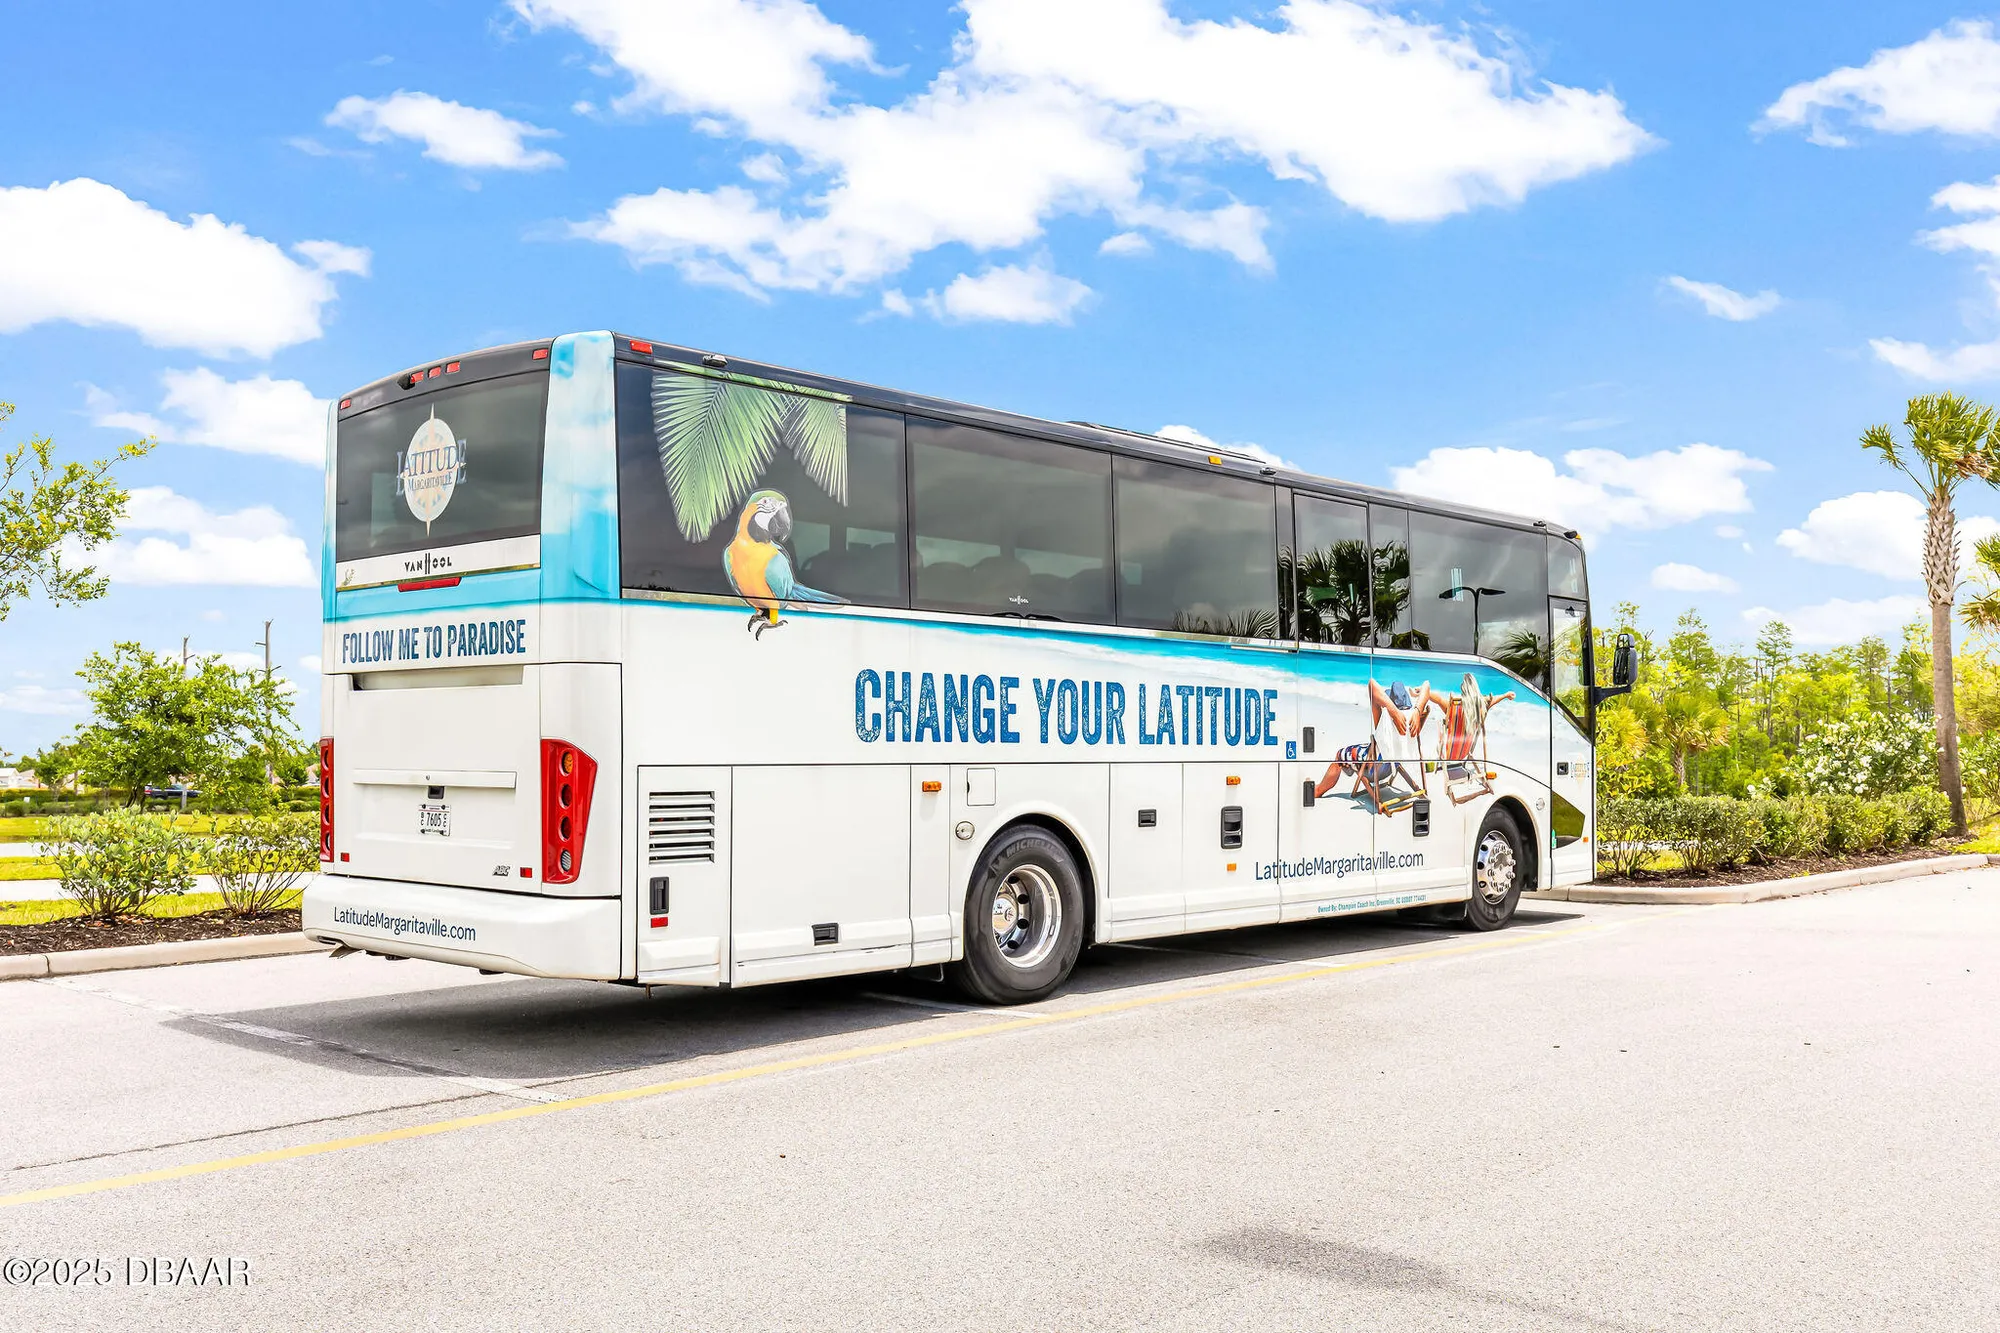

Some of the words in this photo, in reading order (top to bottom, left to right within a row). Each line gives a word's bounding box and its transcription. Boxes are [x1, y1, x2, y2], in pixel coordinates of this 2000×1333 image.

[342, 629, 394, 664] FOLLOW
[398, 627, 420, 660] ME
[423, 625, 442, 659] TO
[447, 619, 526, 658] PARADISE
[855, 668, 1020, 743] CHANGE
[1032, 678, 1126, 746] YOUR
[1138, 683, 1279, 746] LATITUDE
[1255, 851, 1424, 880] LatitudeMargaritaville.com
[334, 906, 476, 941] LatitudeMargaritaville.com
